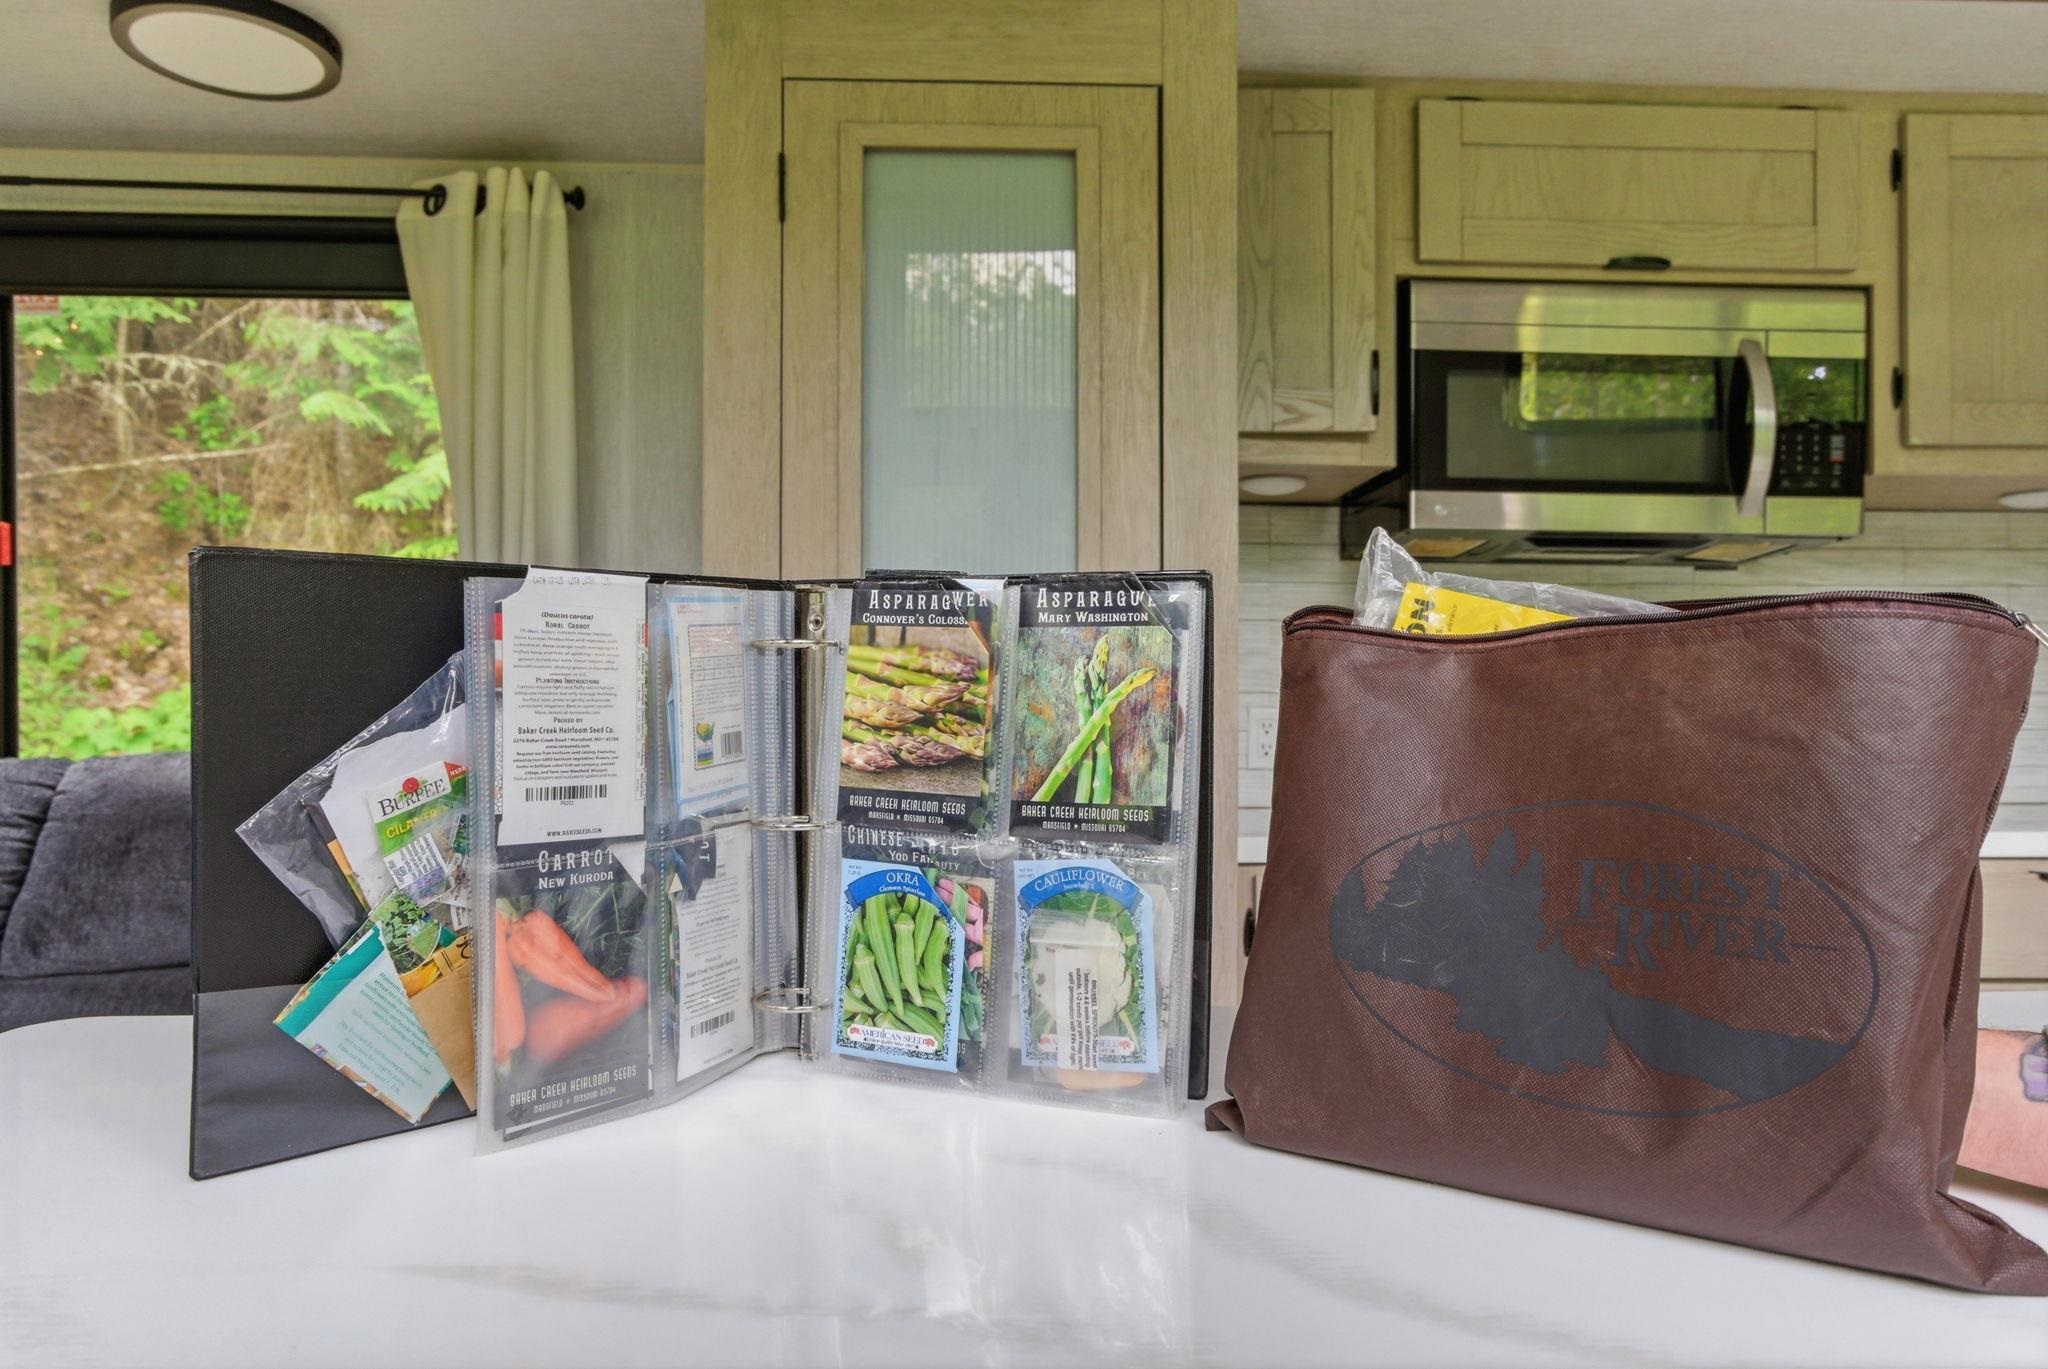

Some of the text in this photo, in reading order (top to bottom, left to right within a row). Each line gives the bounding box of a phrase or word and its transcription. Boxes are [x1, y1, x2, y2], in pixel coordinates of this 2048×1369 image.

[869, 590, 951, 610] ASPARAG
[1036, 588, 1144, 608] ASPARAGU
[862, 612, 967, 625] CONNOVER'S COLOSS
[1038, 611, 1148, 623] MARY WASHINGTON
[378, 778, 448, 817] BURPEE
[850, 795, 966, 815] BAKER CREEK HEIRLOOM SEEDS
[868, 811, 944, 824] MANSFIELD MISSOURI 65704
[1022, 805, 1149, 822] BAKER CREEK HEIRLOOM SEEDS
[848, 824, 904, 847] CHINESE
[1042, 821, 1126, 832] MANSFIELD MISSOURI 65704
[888, 850, 908, 862] YOD
[538, 871, 614, 890] NEW KURODA
[886, 872, 919, 886] OKRA
[1034, 869, 1125, 892] CAULIFLOWER
[1576, 858, 1782, 918] FOREST
[1609, 904, 1792, 971] RIVER
[510, 1065, 637, 1107] BAKER CREEK HEIRLOOM SEEDS
[533, 1099, 563, 1113] MANSFIELD
[573, 1090, 598, 1103] MISSOURI
